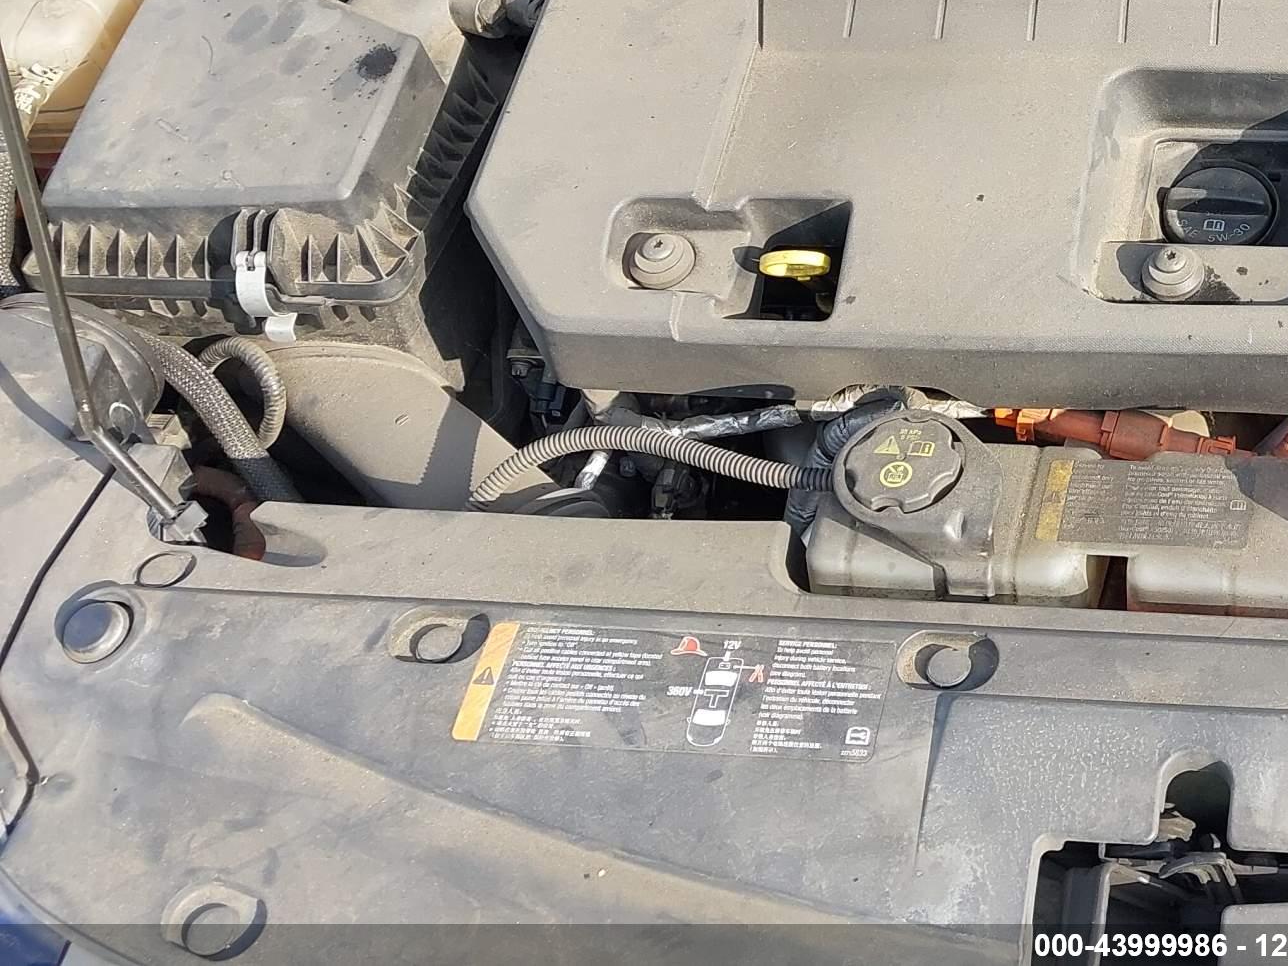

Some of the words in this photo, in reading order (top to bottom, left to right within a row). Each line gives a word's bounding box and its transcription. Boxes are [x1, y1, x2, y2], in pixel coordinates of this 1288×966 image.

[1175, 219, 1200, 238] SAE
[723, 640, 741, 650] 12V
[666, 685, 693, 696] 360V
